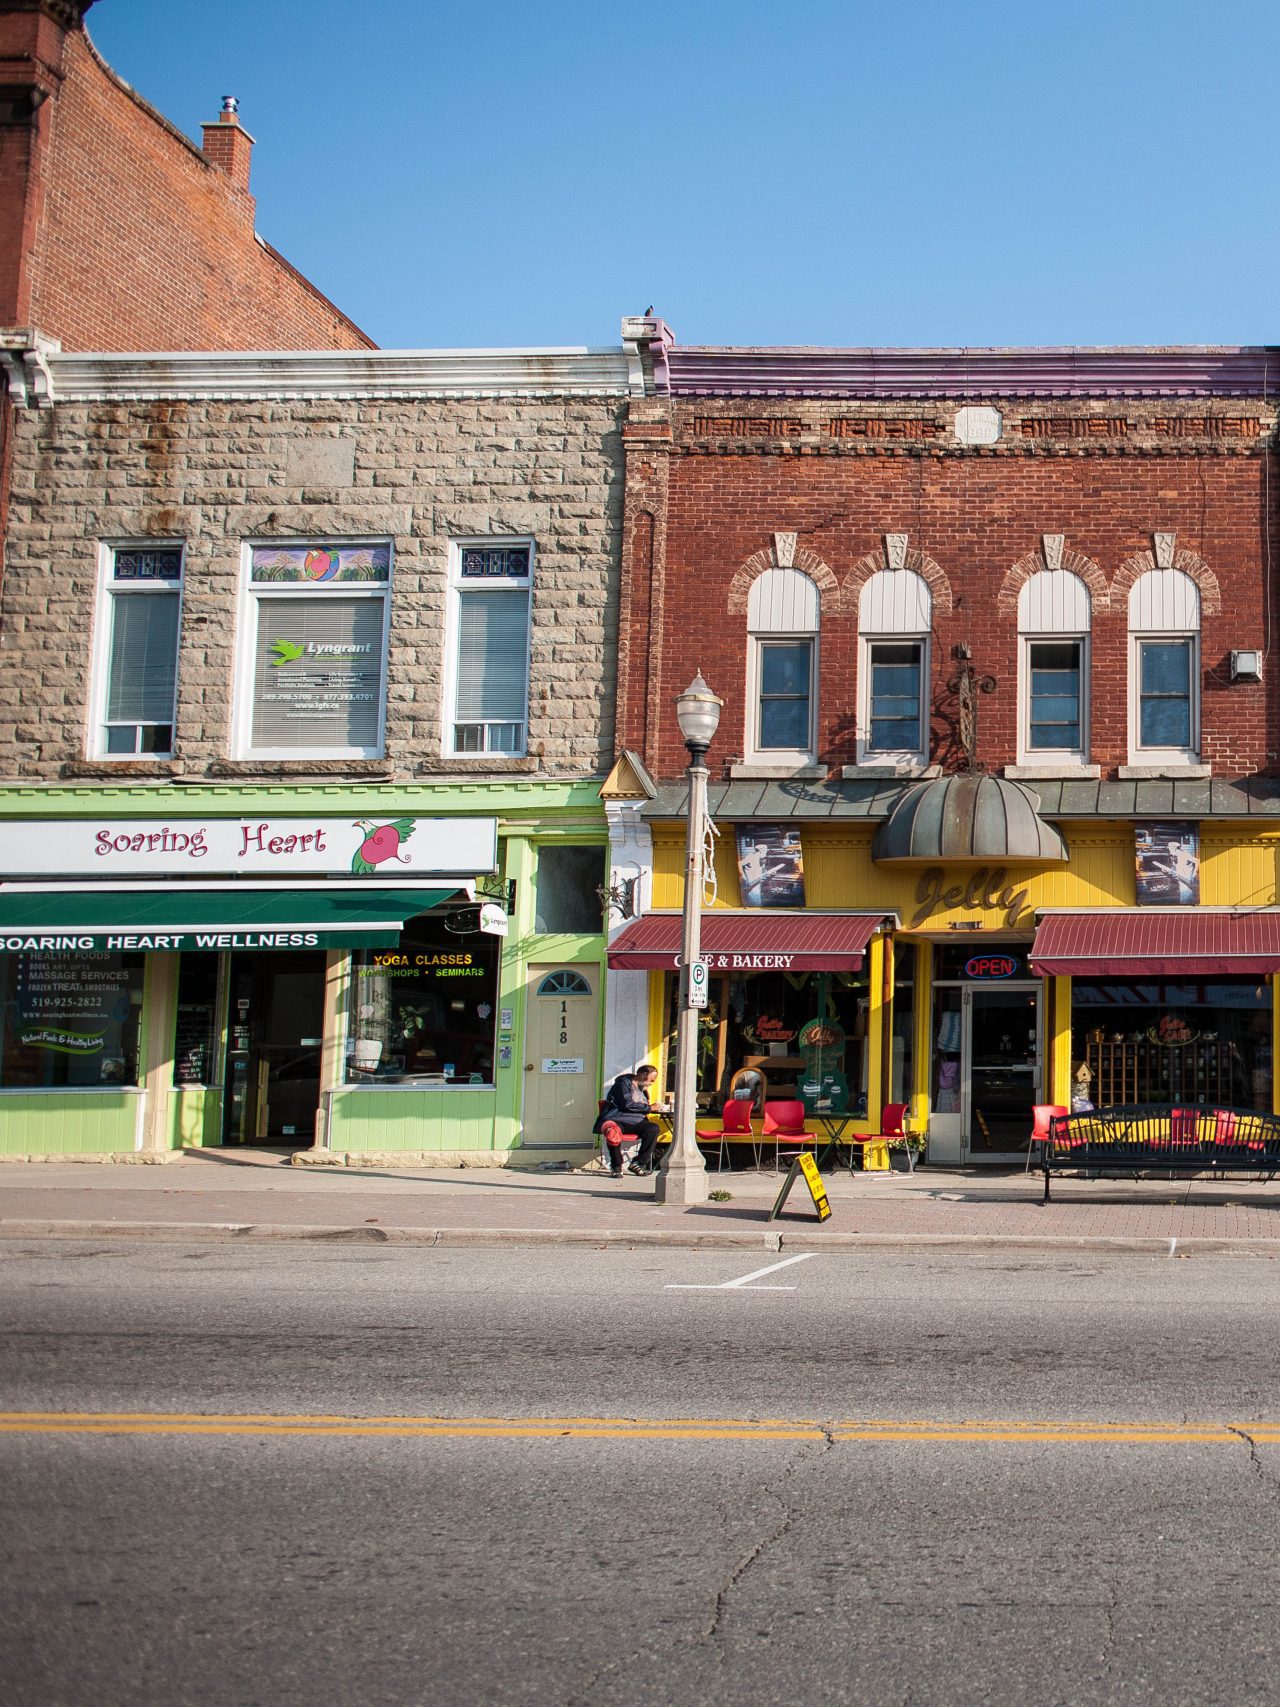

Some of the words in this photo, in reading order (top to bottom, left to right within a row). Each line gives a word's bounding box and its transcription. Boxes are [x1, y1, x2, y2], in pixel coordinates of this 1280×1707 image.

[307, 642, 372, 655] Lyngrant
[94, 827, 208, 858] Soaring
[238, 823, 327, 857] Heart
[911, 867, 1031, 929] Jelly
[107, 936, 184, 949] HEART
[196, 934, 319, 947] WELLNESS
[30, 952, 70, 960] HEALTH
[76, 952, 110, 960] FOODS
[374, 955, 409, 966] YOGA
[416, 954, 472, 965] CLASSES
[674, 954, 716, 967] CFÉ
[717, 955, 729, 967] &
[732, 955, 795, 968] BAKERY
[358, 968, 420, 977] WORKSHOPS
[436, 968, 484, 976] SEMINARS
[967, 959, 1013, 975] OPEN
[29, 972, 77, 980] MASSAGE
[80, 971, 130, 980] SERVICES
[696, 969, 703, 980] P
[28, 984, 52, 992] FROZEN
[84, 984, 120, 992] SMOOTHIES
[32, 998, 103, 1007] 519-925-2822
[22, 1032, 42, 1044] Natural
[42, 1031, 58, 1042] Foods
[58, 1034, 66, 1042] &
[66, 1037, 88, 1048] Healthy
[88, 1037, 104, 1046] Living
